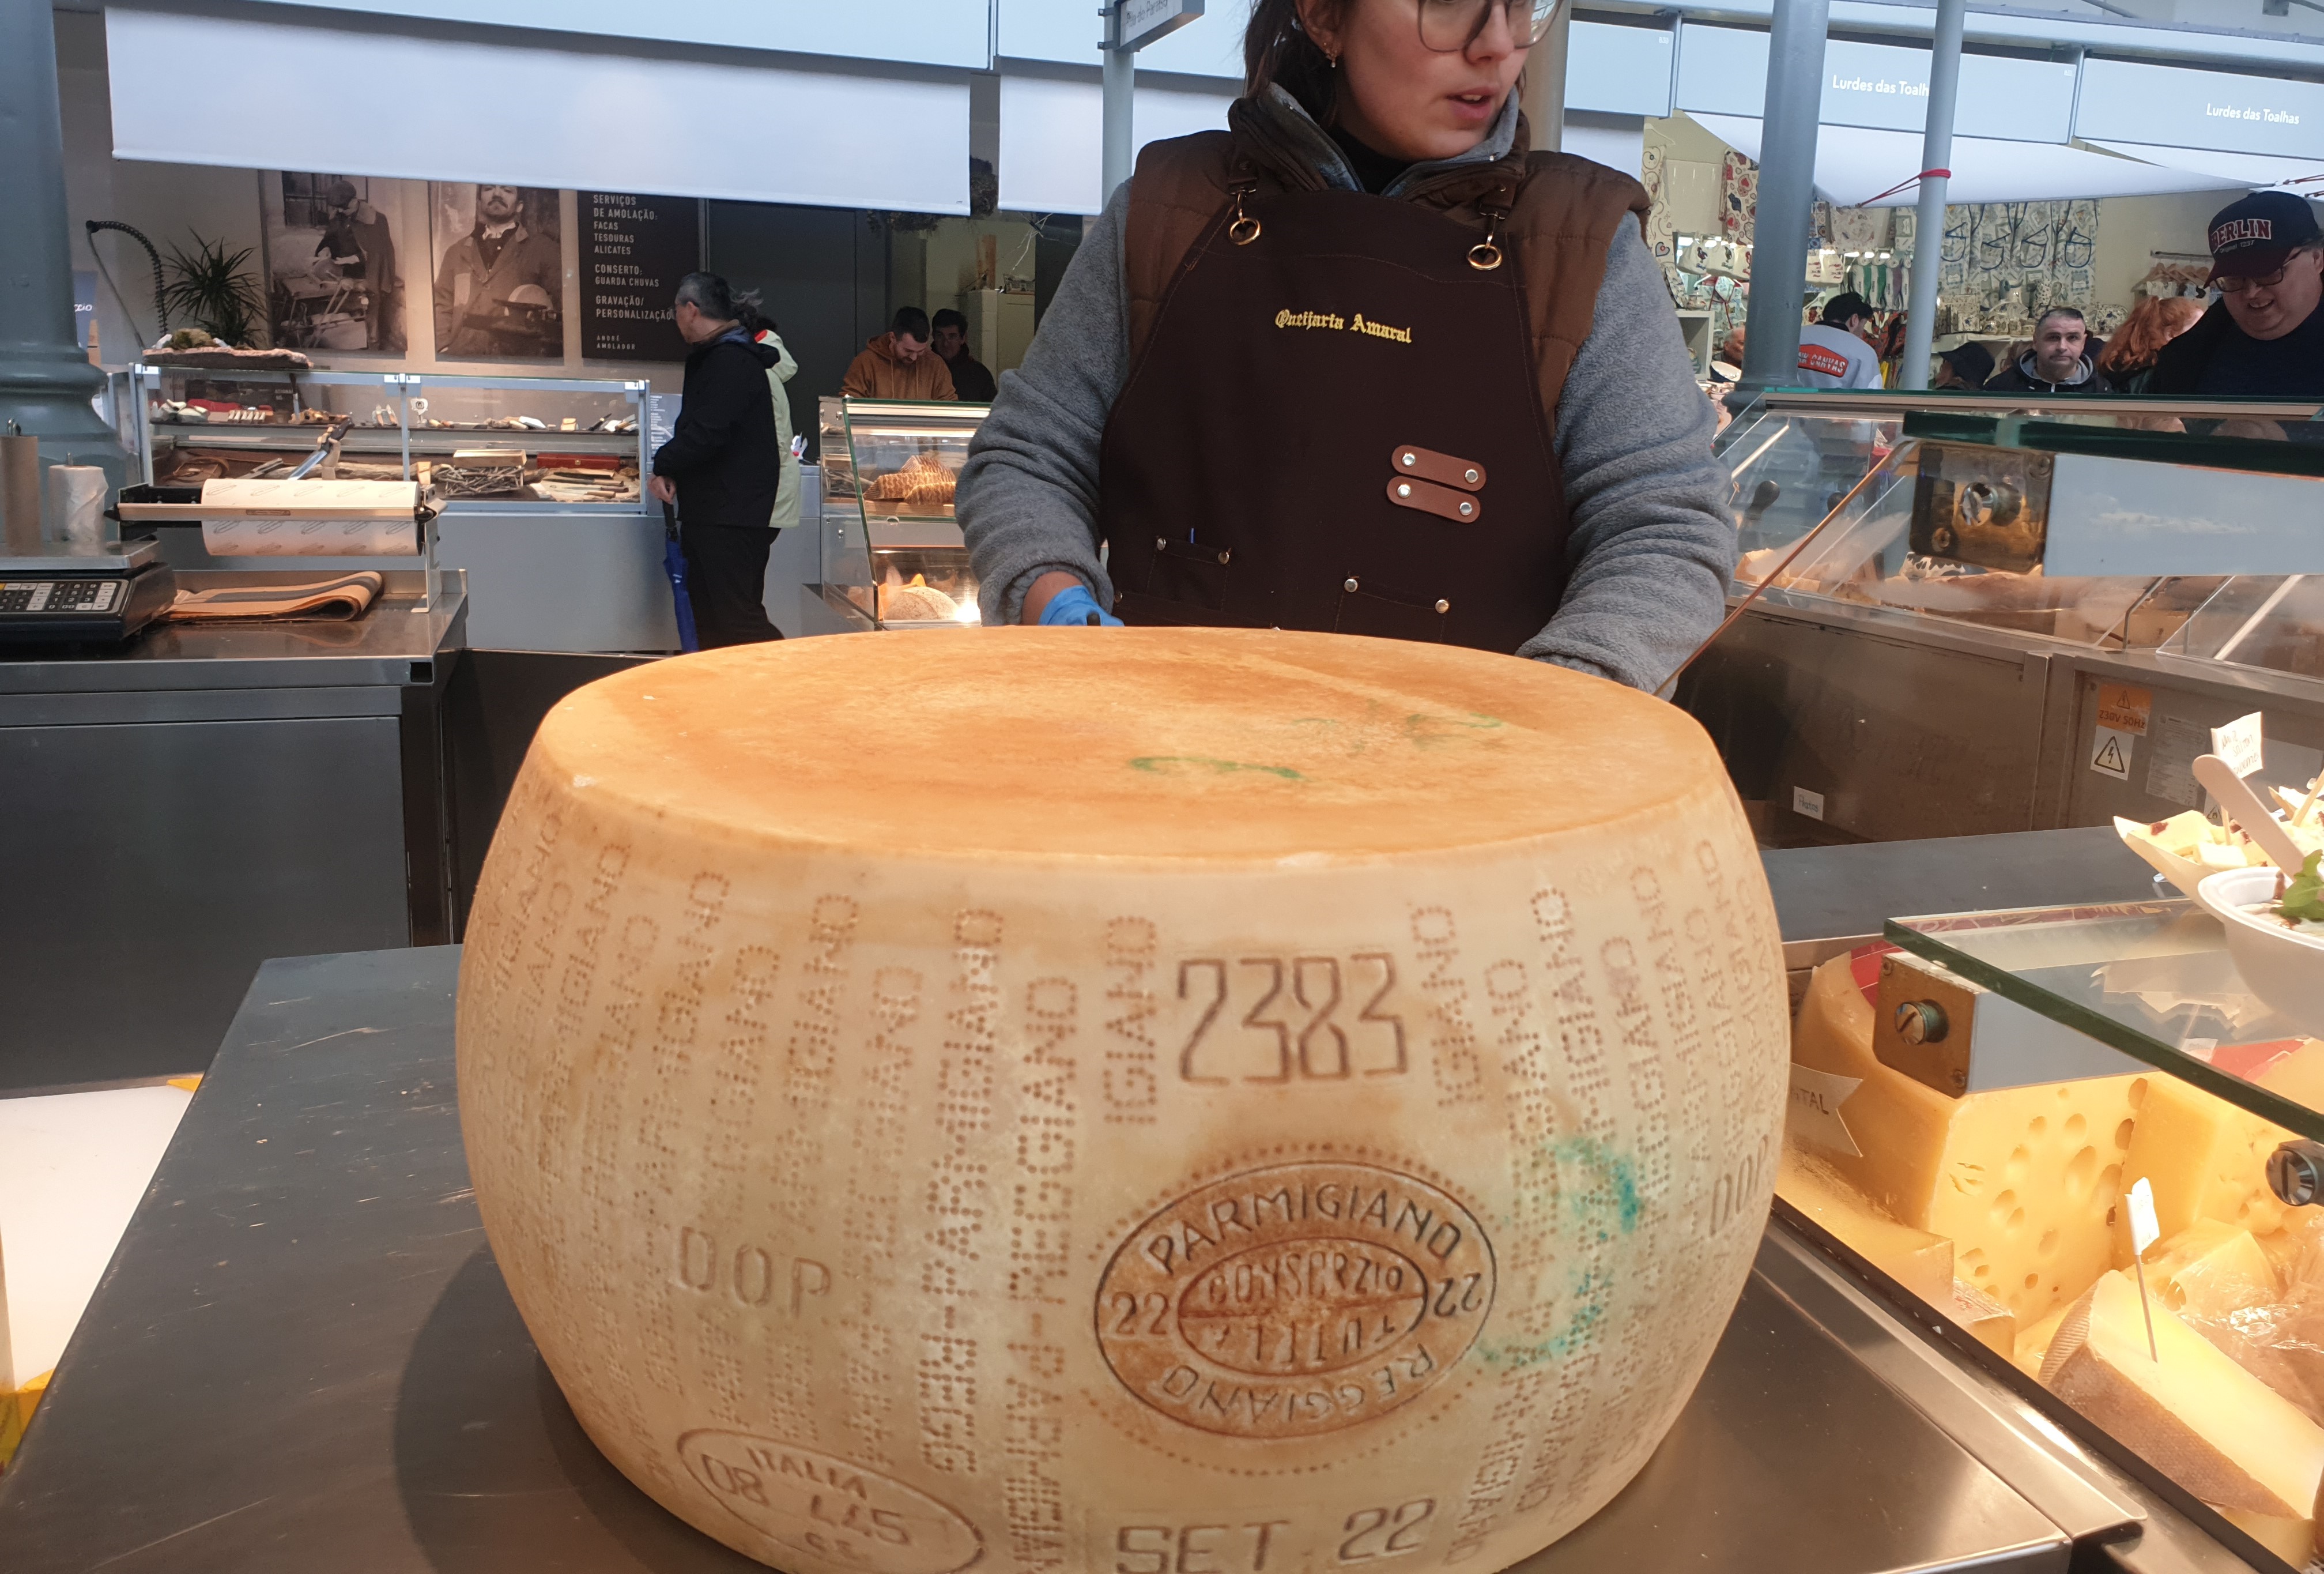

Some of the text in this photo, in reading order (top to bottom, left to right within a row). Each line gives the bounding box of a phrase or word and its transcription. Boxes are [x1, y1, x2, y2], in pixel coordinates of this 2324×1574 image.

[1832, 74, 1929, 96] Lurdes das Toalh
[2206, 103, 2300, 125] Lurdes das Toalhas
[593, 194, 636, 206] SERVIÇOS
[594, 208, 605, 217] DE
[594, 221, 618, 230] FACAS
[2210, 219, 2272, 254] BERLIN
[594, 233, 634, 243] TESOURAS
[594, 245, 631, 255] ALICATES
[595, 263, 643, 275] CONSERTO:
[595, 276, 659, 287] GUARDA CHUVAS
[595, 295, 644, 307] GRAVAÇÃO/
[1349, 312, 1412, 344] Amaral
[1810, 354, 1846, 373] CANVAS
[2099, 709, 2121, 722] 230V
[1798, 794, 1819, 812] Pratos
[1177, 951, 1408, 1086] 2383
[1148, 1183, 1463, 1276] PARMIGIANO
[678, 1225, 831, 1319] DOP
[1209, 1249, 1404, 1305] CONSORZIO
[1433, 1272, 1482, 1318] 22
[1110, 1291, 1169, 1336] 22
[1161, 1343, 1434, 1424] REGGIANO
[748, 1447, 867, 1501] ITALIA
[1116, 1498, 1435, 1573] SET 22
